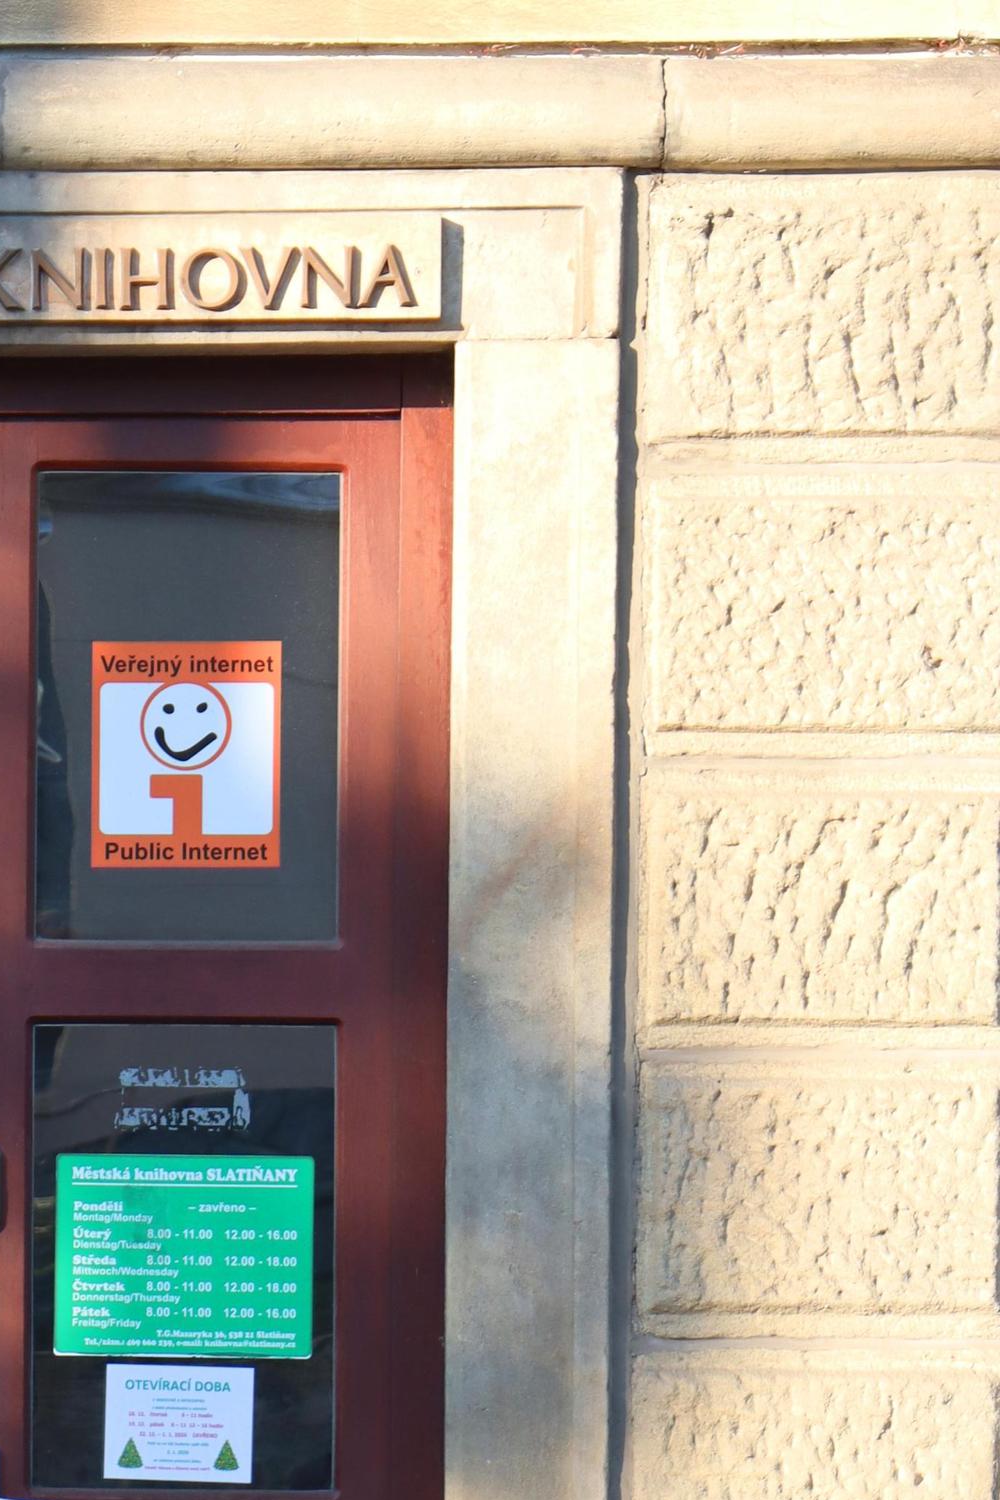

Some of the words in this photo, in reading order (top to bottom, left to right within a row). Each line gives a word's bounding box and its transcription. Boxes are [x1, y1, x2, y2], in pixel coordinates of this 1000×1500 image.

[101, 655, 182, 677] Veřejný
[190, 655, 274, 673] internet
[105, 842, 174, 860] Public
[182, 843, 267, 861] Internet
[72, 1166, 131, 1180] Městská
[134, 1167, 203, 1181] knihovna
[206, 1166, 298, 1182] SLATIŇANY
[73, 1201, 124, 1212] Pondělí
[199, 1203, 246, 1213] zavřeno
[73, 1212, 153, 1224] Montag/Monday
[73, 1226, 112, 1240] Úterý
[147, 1229, 171, 1239] 8.00
[183, 1229, 213, 1240] 11.00
[224, 1230, 255, 1240] 12.00
[267, 1230, 298, 1240] 16.00
[73, 1240, 162, 1251] Dienstag/Tuesday
[72, 1254, 117, 1266] Středa
[146, 1255, 171, 1265] 8.00
[182, 1255, 213, 1266] 11.00
[224, 1256, 255, 1266] 12.00
[266, 1256, 297, 1267] 18.00
[72, 1266, 179, 1278] Mittwoch/Wednesday
[72, 1279, 125, 1291] Čtvrtek
[146, 1281, 171, 1291] 8.00
[182, 1281, 212, 1292] 11.00
[223, 1282, 254, 1292] 12.00
[266, 1282, 297, 1293] 18.00
[72, 1292, 180, 1304] Donnerstag/Thursday
[72, 1306, 110, 1317] Pátek
[145, 1307, 170, 1317] 8.00
[182, 1307, 212, 1318] 11.00
[223, 1308, 254, 1318] 12.00
[265, 1308, 296, 1319] 16.00
[72, 1318, 141, 1329] Freitag/Friday
[156, 1330, 213, 1340] T.G.Masaryka
[256, 1331, 296, 1341] Slatiňany
[125, 1377, 192, 1391] OTEVÍRACÍ
[195, 1381, 231, 1392] DOBA
